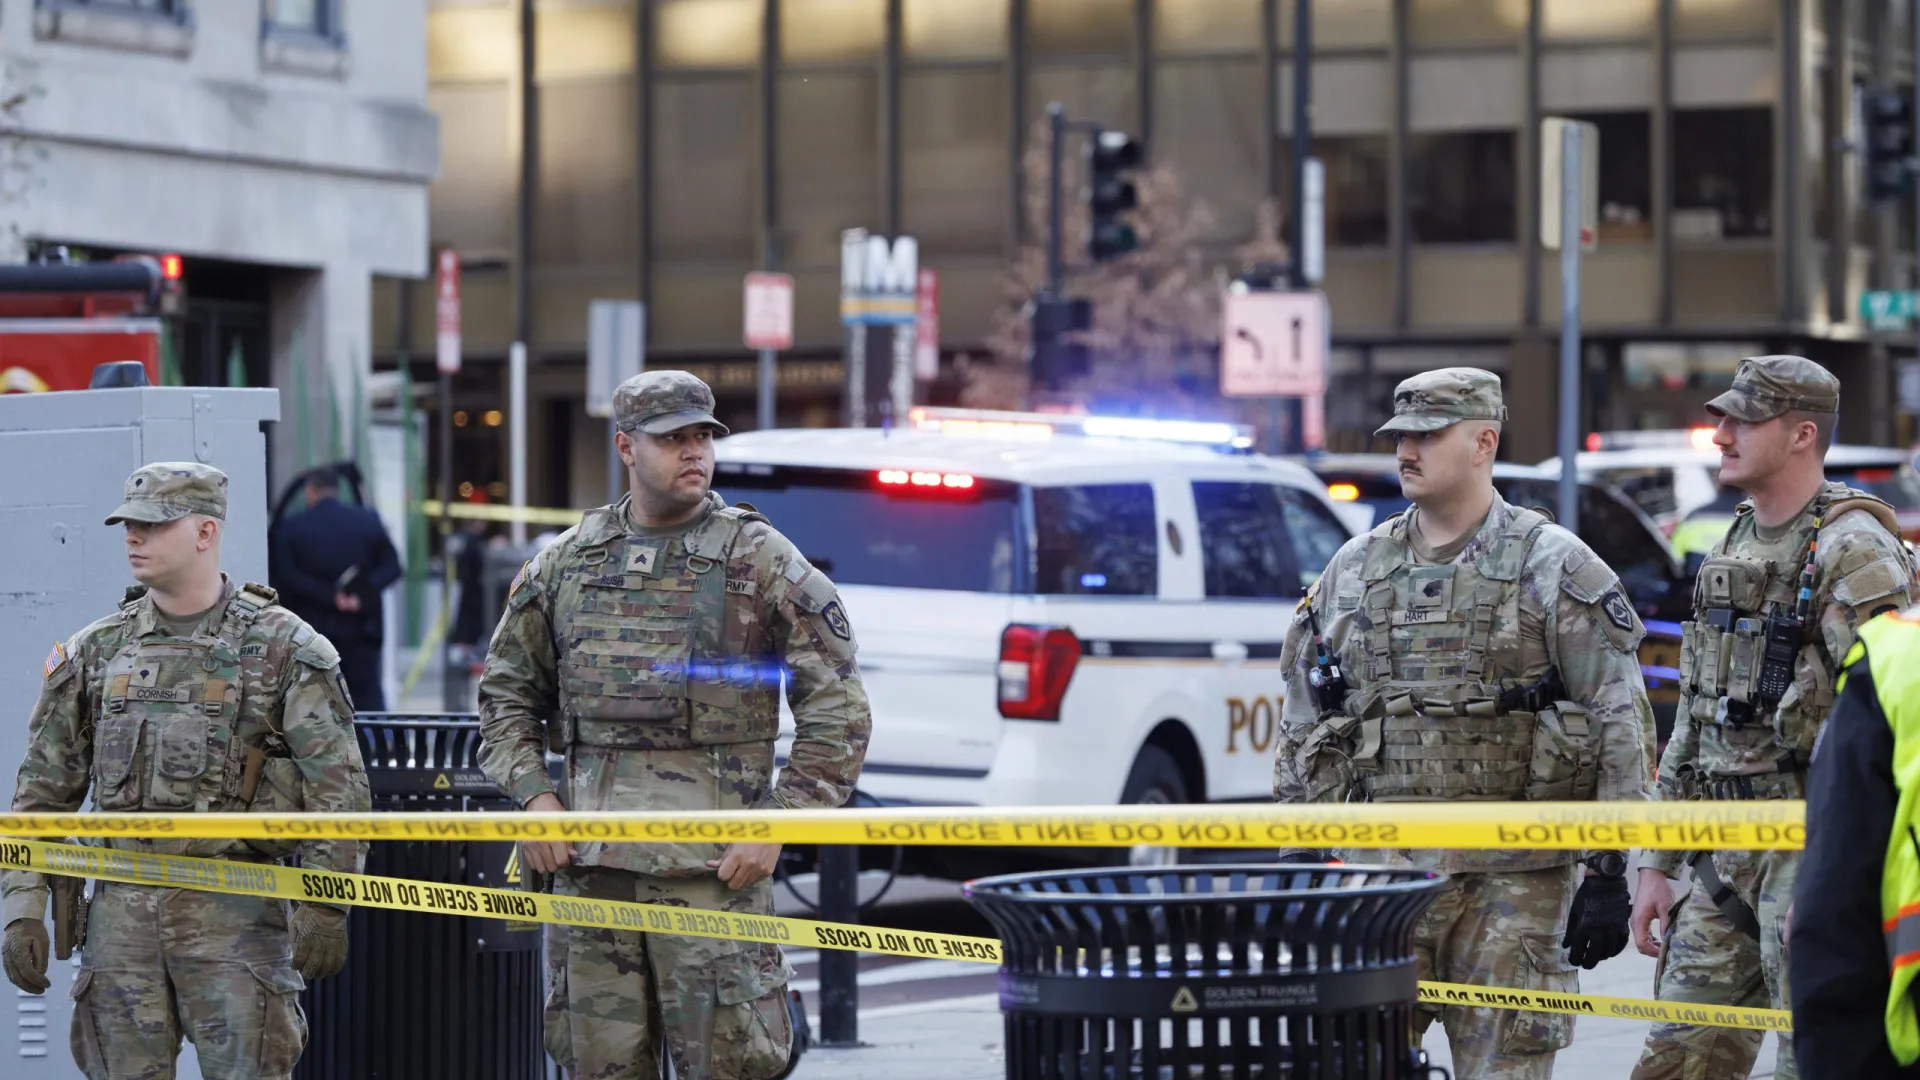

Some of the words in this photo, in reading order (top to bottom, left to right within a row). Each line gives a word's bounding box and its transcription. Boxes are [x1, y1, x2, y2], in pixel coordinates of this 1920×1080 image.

[600, 575, 625, 587] RUSH
[725, 580, 748, 592] RMY
[1404, 610, 1429, 622] HART
[240, 645, 262, 656] RMY
[137, 689, 177, 700] CORNISH
[103, 852, 135, 878] NOT
[139, 856, 163, 881] DO
[221, 863, 277, 892] CRIME
[302, 873, 357, 901] CROSS
[361, 879, 393, 904] NOT
[397, 883, 421, 906] DO
[424, 886, 479, 912] SCENE
[481, 891, 537, 918] CRIME
[550, 900, 606, 925] CROSS
[611, 904, 645, 927] NOT
[647, 909, 673, 930] DO
[674, 912, 731, 935] SCENE
[733, 917, 790, 941] CRIME
[815, 926, 872, 949] CROSS
[876, 932, 909, 952] NOT
[913, 936, 938, 955] DO
[940, 939, 998, 960] SCENE
[1204, 986, 1257, 999] GOLDEN
[1260, 983, 1317, 998] TRIANGLE
